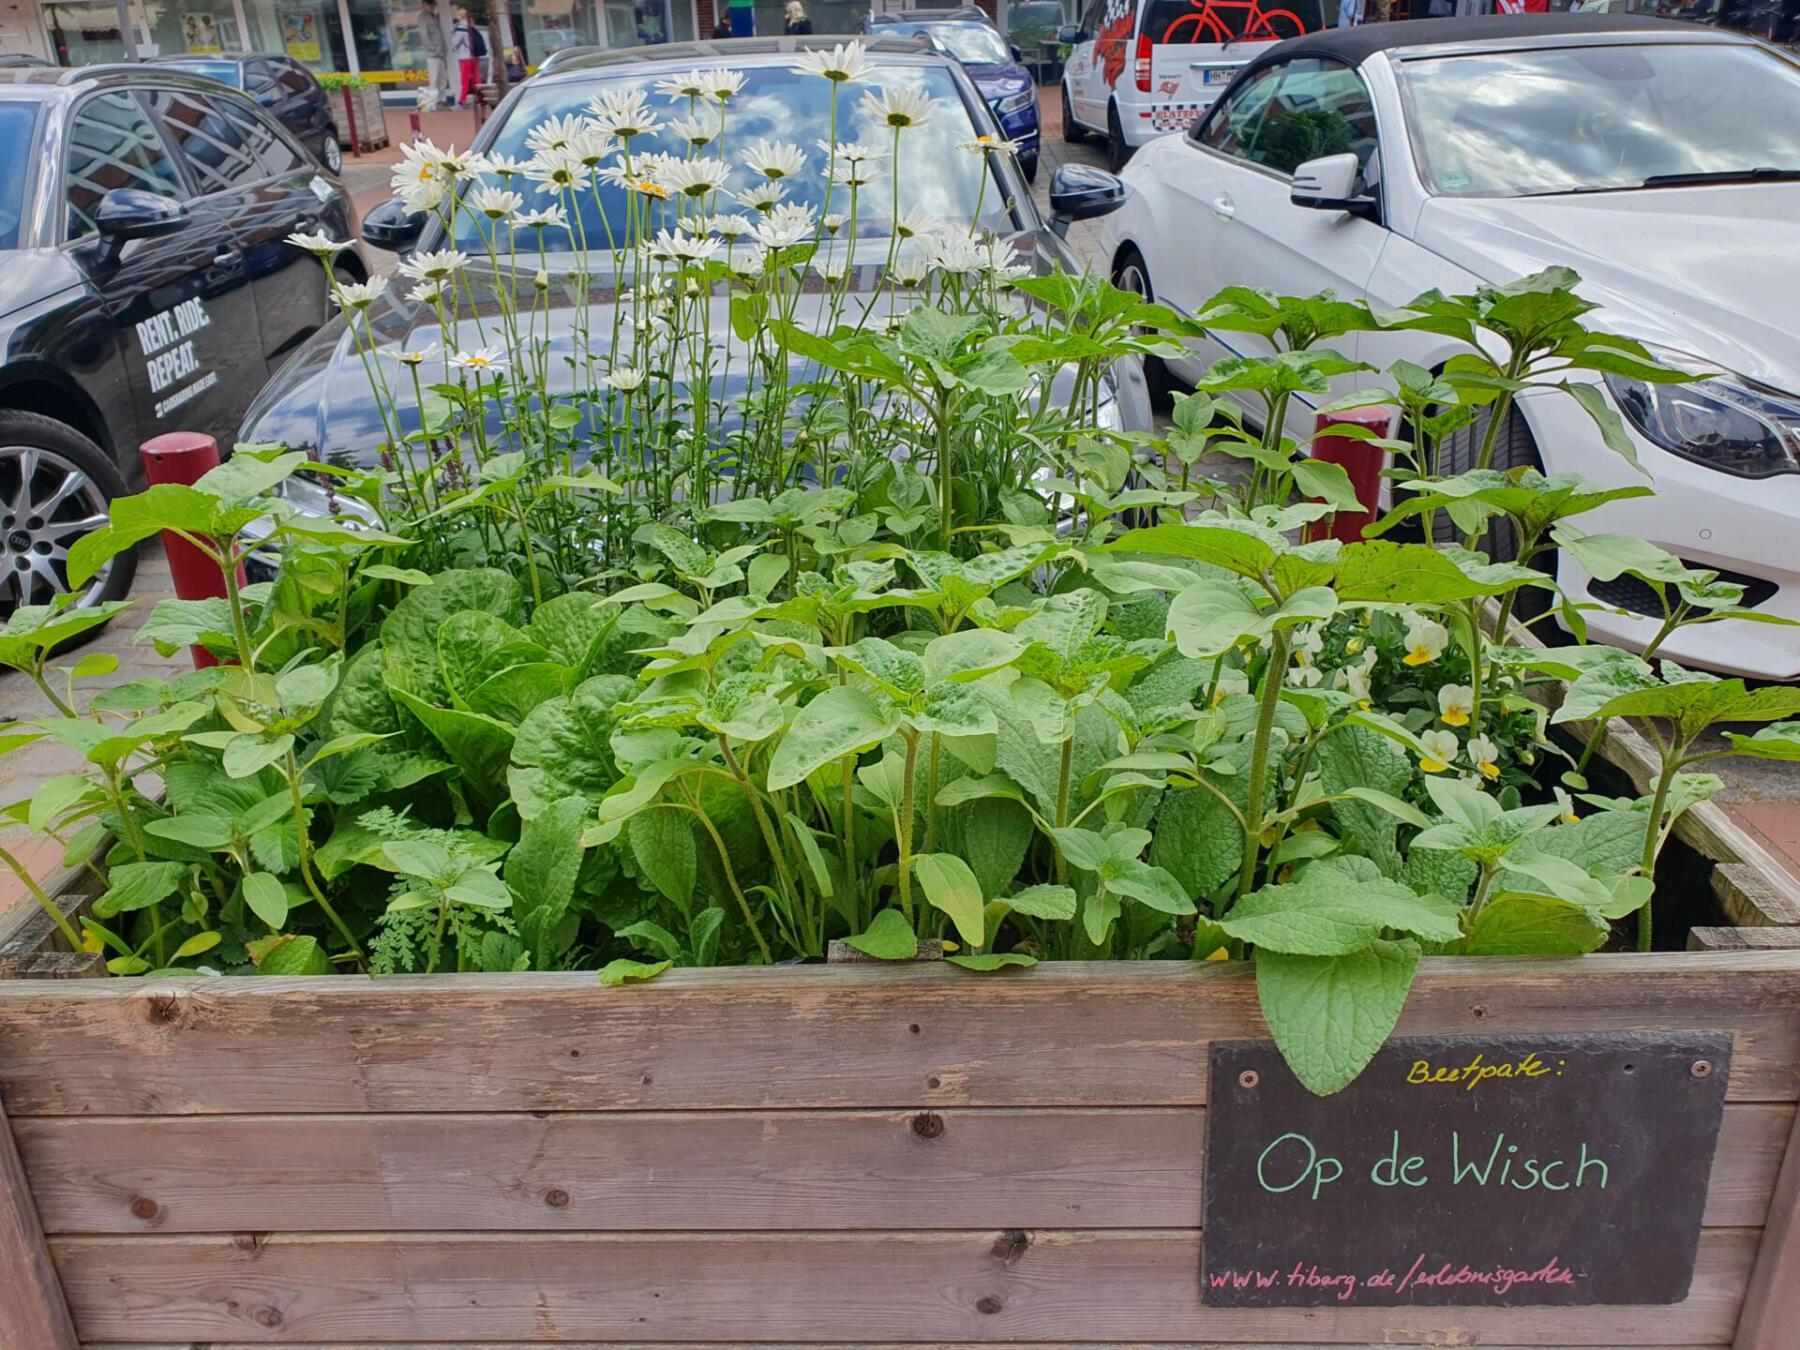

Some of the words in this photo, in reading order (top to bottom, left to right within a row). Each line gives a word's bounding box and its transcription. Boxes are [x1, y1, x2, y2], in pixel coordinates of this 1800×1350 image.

[136, 311, 179, 355] RENT.
[174, 296, 210, 336] RIDE.
[146, 340, 199, 393] REPEAT.
[1257, 1132, 1344, 1201] Op
[1371, 1129, 1428, 1187] de
[1452, 1131, 1609, 1190] Wisch
